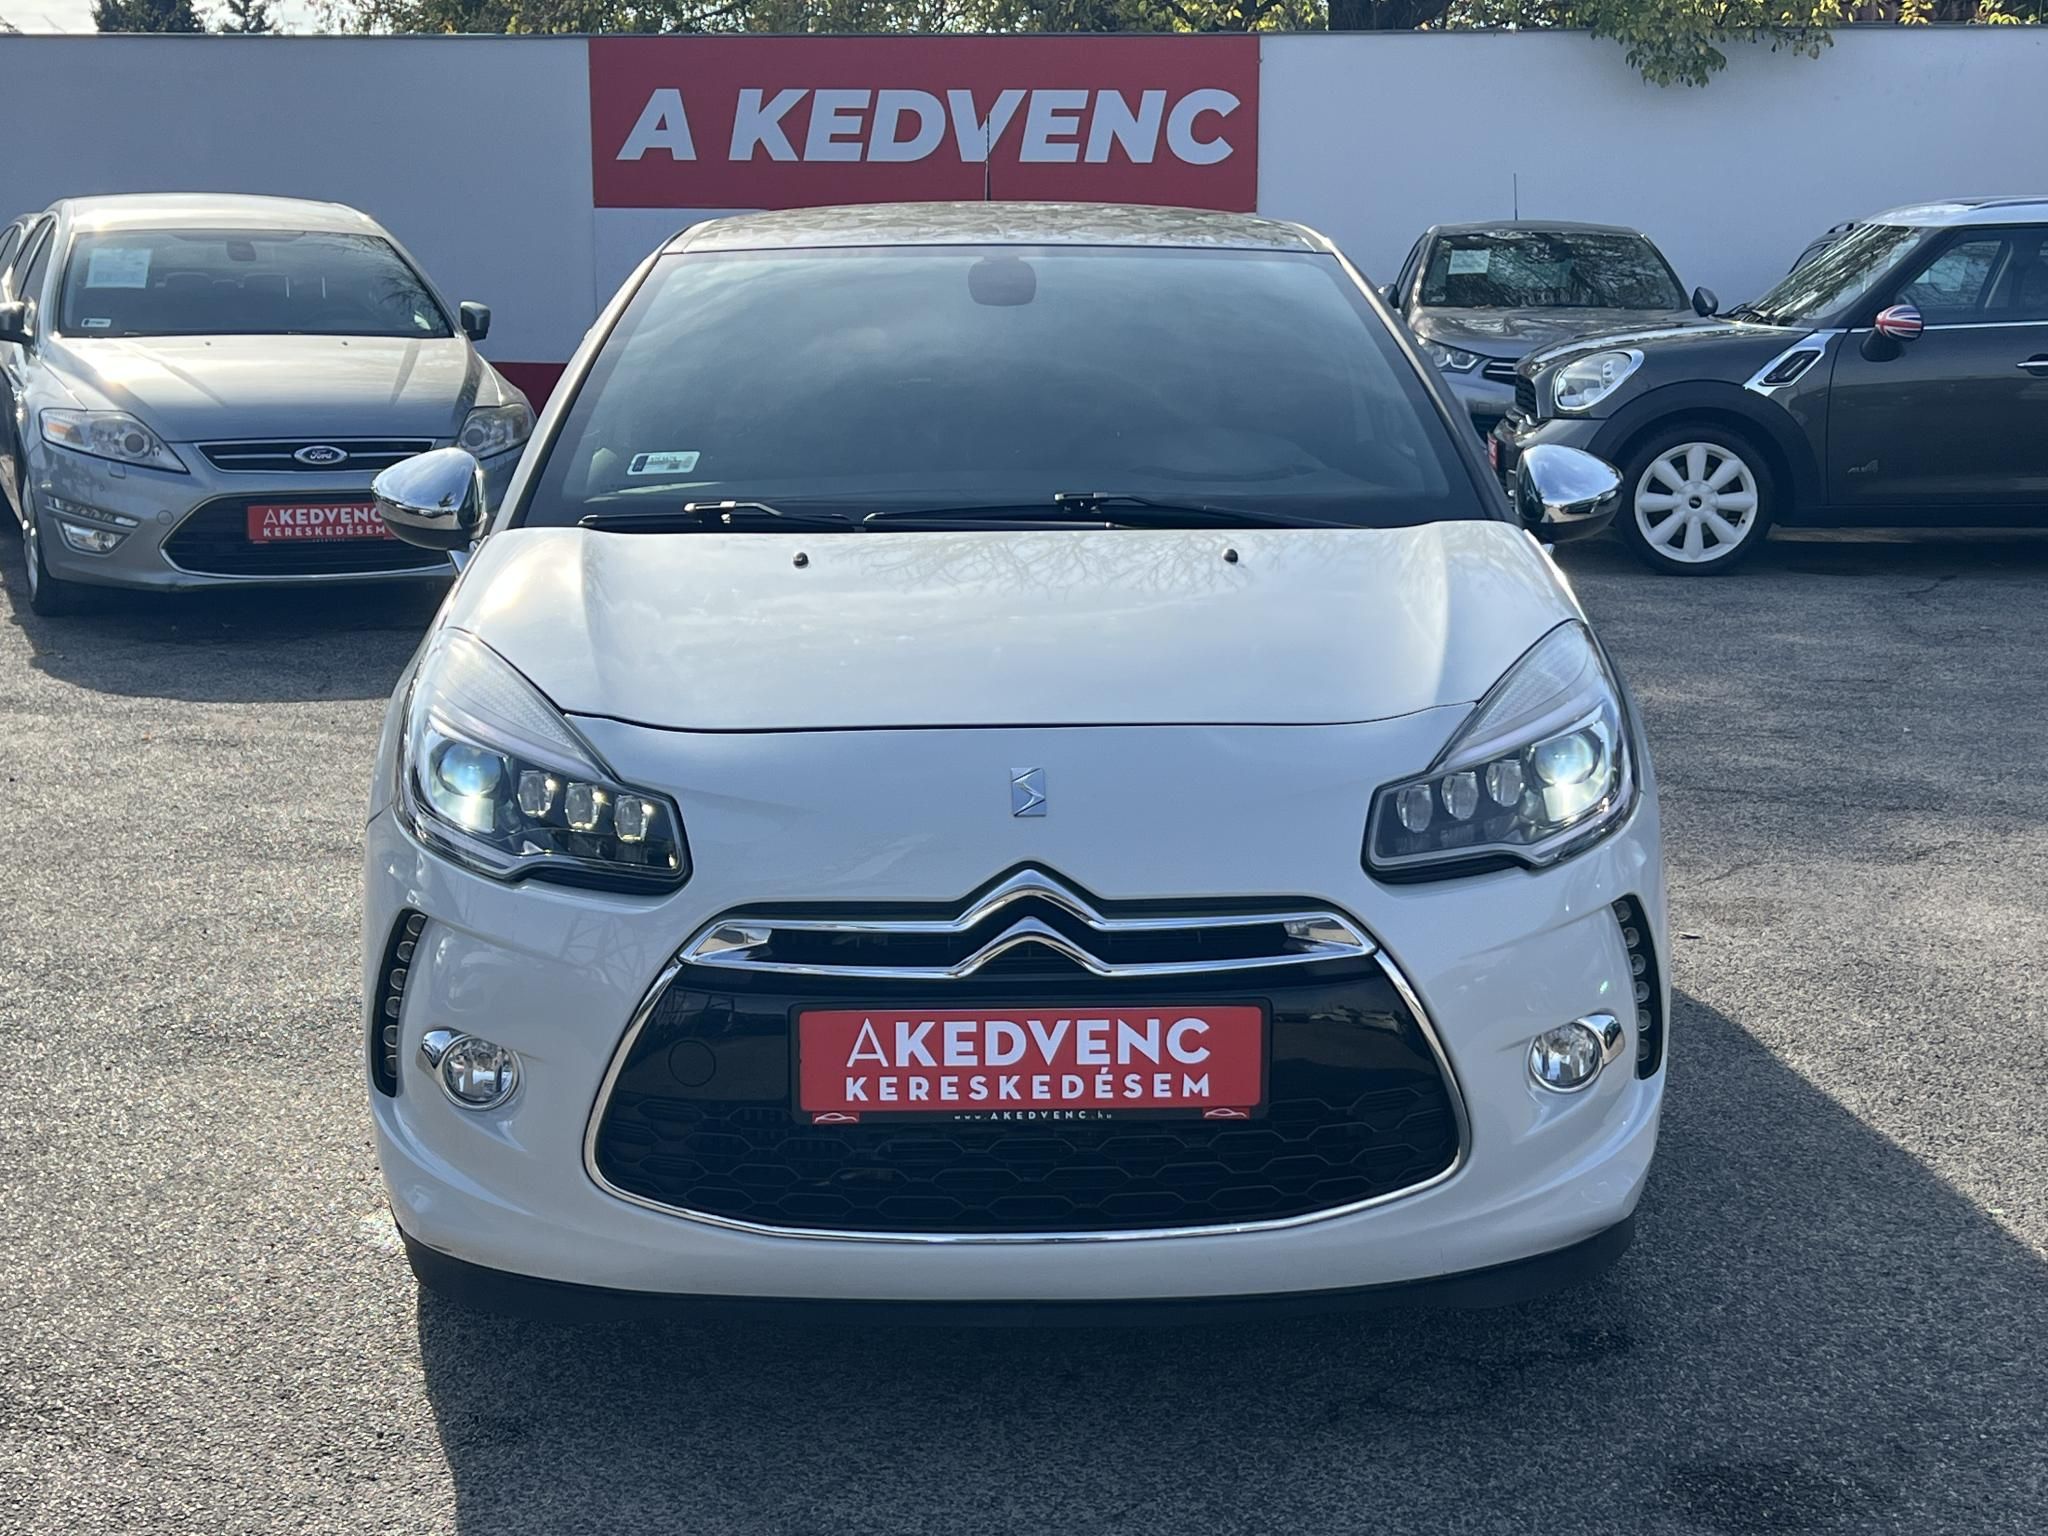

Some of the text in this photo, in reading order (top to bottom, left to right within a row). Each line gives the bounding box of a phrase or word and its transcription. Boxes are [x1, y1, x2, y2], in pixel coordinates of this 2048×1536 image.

[616, 88, 1241, 165] A KEDVENC
[310, 449, 333, 460] Ford
[263, 524, 386, 537] KERESKEDÉSEM
[845, 1067, 1210, 1102] KERESKEDÉSEM
